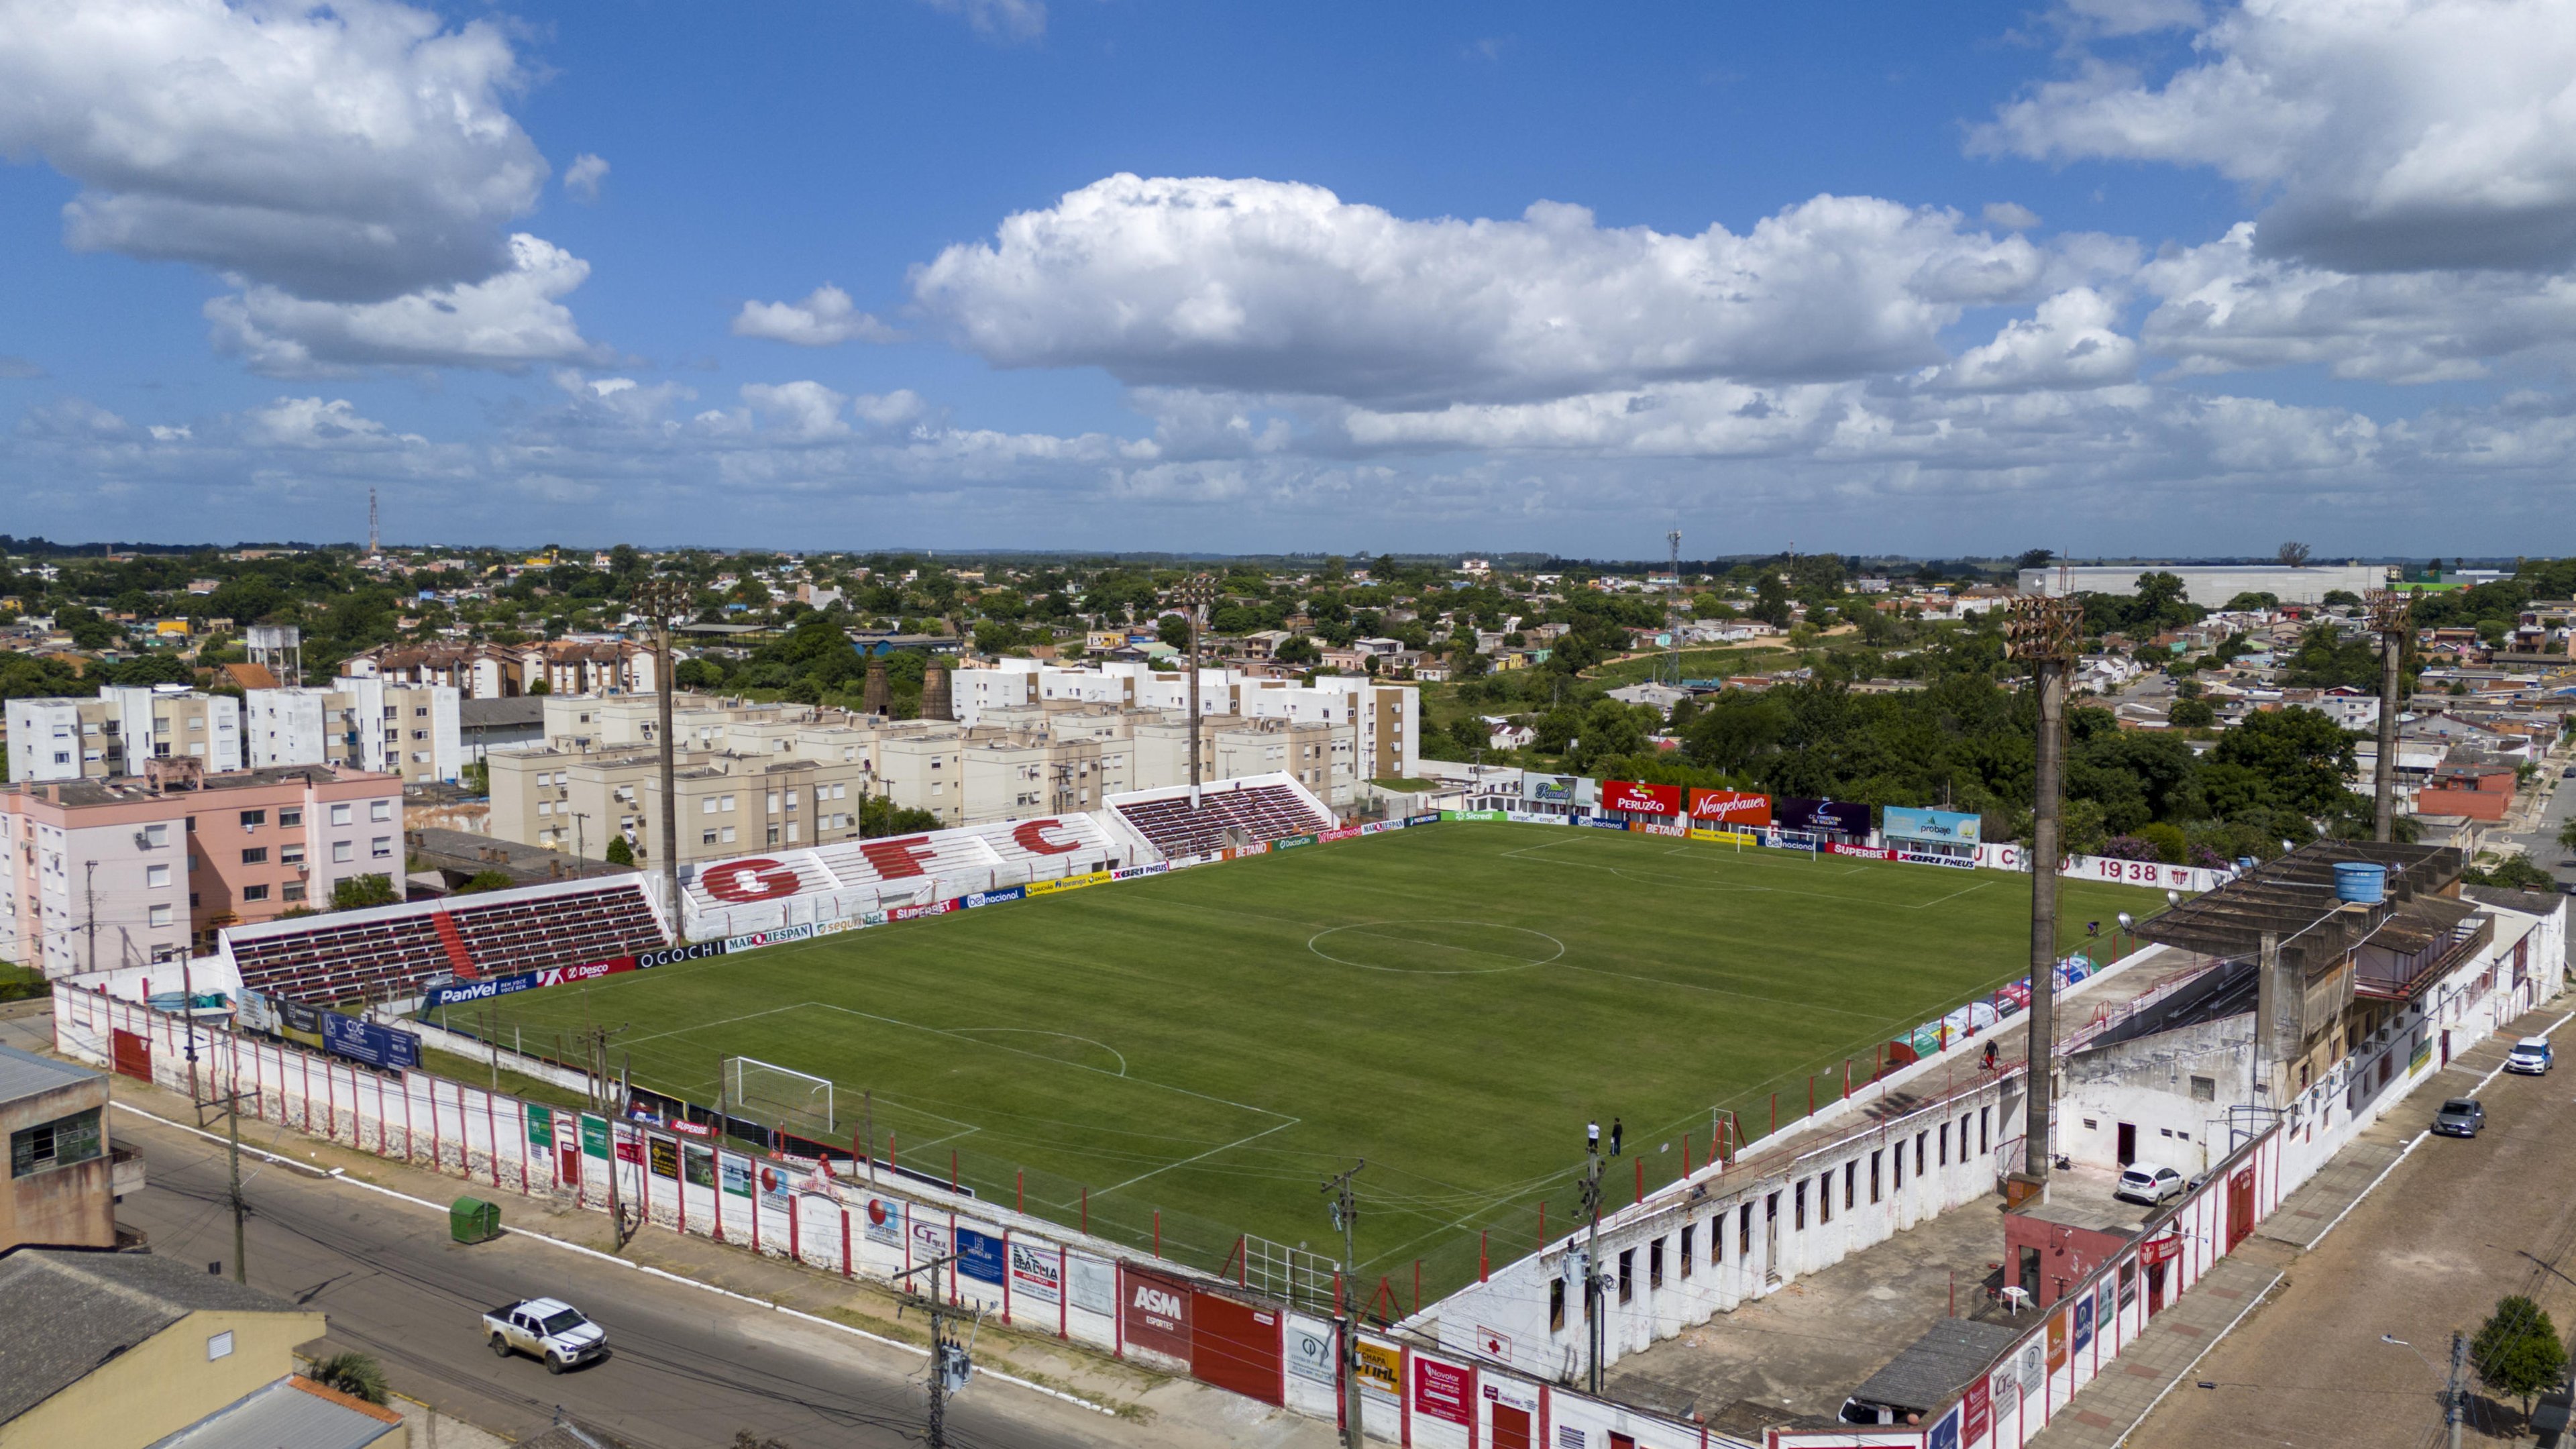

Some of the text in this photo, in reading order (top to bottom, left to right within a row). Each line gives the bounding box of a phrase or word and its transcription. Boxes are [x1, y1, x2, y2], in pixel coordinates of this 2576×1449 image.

[1617, 798, 1665, 812] PERUZZO
[1693, 793, 1767, 821] Neugebauer
[1466, 812, 1493, 820] Sicredi
[1363, 819, 1403, 833] MARQUESPAN
[1646, 823, 1685, 837] BETANO
[1921, 825, 1951, 836] probaje
[1236, 843, 1267, 858] BETANO
[1834, 844, 1890, 859] SUPERBET
[1146, 863, 1167, 873] PNEUS
[1944, 858, 1974, 869] PNEUS
[2099, 859, 2157, 881] 1938
[896, 900, 951, 920] SUPERBET
[729, 926, 808, 949] MARQUESPAN
[641, 941, 721, 968] OGOCHI
[579, 964, 608, 975] Desco
[440, 982, 497, 1004] PanVel
[1134, 1285, 1181, 1320] ASM
[1146, 1316, 1173, 1331] ESPORTES
[1361, 1352, 1386, 1364] CHAPA
